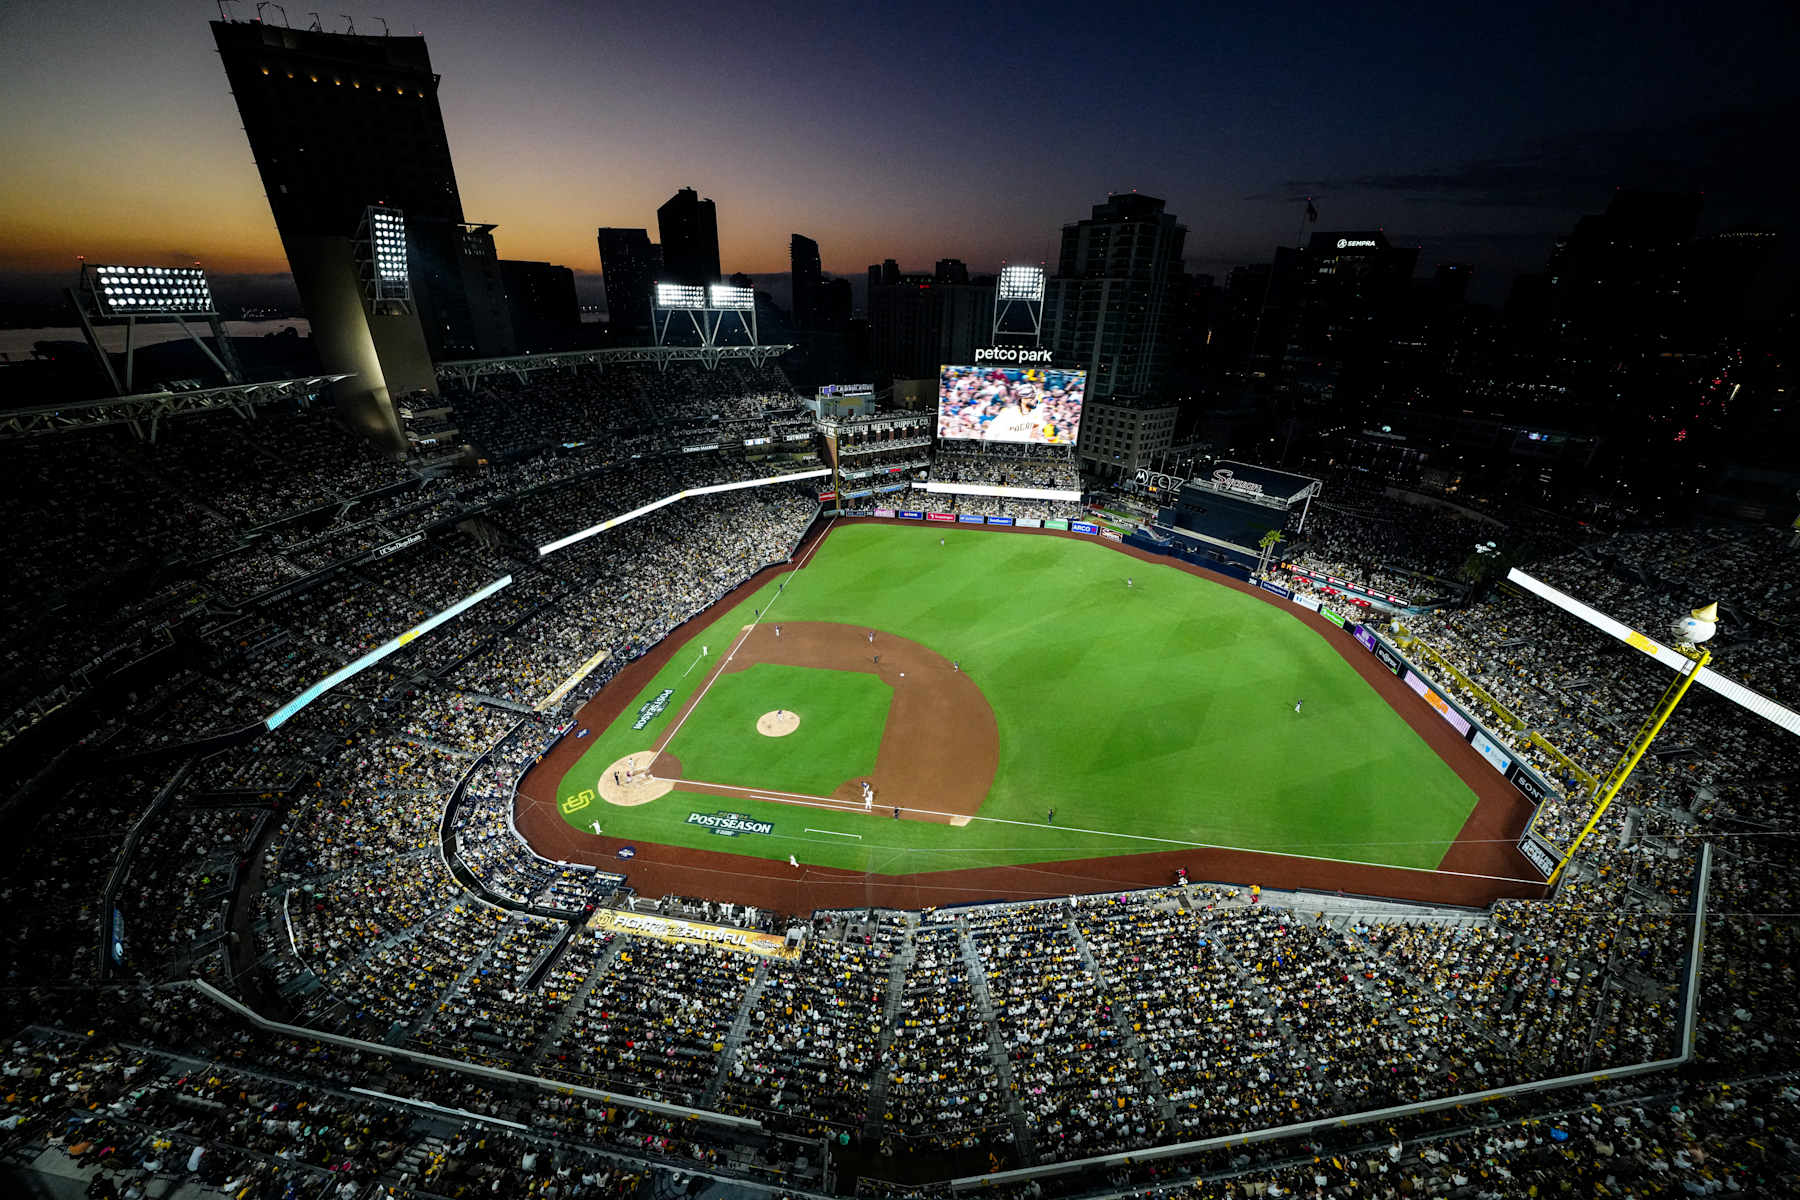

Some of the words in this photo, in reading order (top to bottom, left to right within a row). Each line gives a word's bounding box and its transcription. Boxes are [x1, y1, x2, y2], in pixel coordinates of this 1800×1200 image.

[975, 346, 1018, 362] petco
[1018, 349, 1053, 364] park
[837, 424, 869, 435] WESTERN
[870, 421, 892, 432] METAL
[893, 418, 918, 429] SUPPLY
[1213, 469, 1263, 492] Sycuan
[632, 689, 673, 729] POSTSEASON
[687, 812, 773, 834] POSTSEASON
[1521, 841, 1554, 877] HOMERS
[684, 927, 748, 947] FAITHFUL
